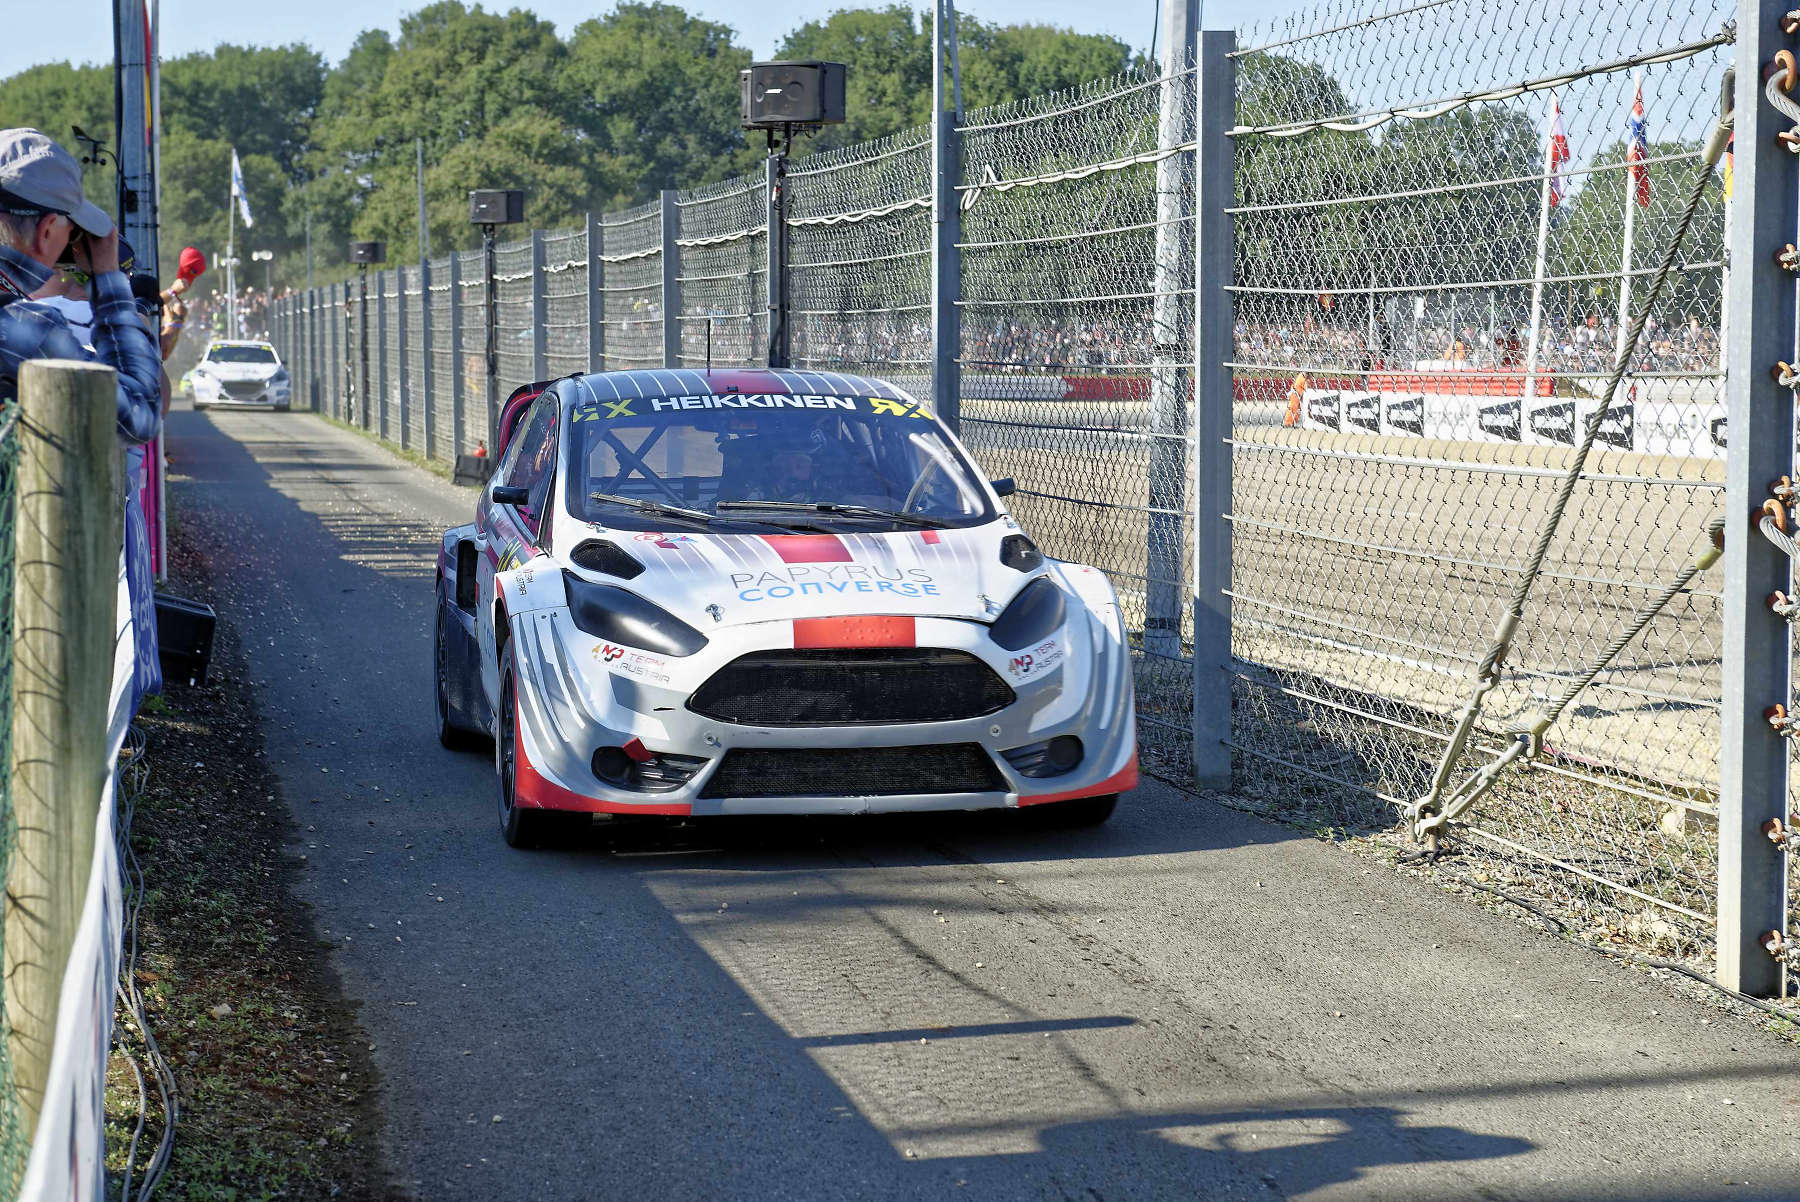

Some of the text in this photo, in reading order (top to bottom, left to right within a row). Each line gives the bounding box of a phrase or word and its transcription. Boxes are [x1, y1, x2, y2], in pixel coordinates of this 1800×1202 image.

[651, 394, 857, 412] HEIKKINEN
[730, 565, 933, 588] PAPYRUS
[738, 580, 941, 602] CONVERSE
[630, 652, 665, 667] TEAM
[620, 662, 671, 684] AUSTRIA
